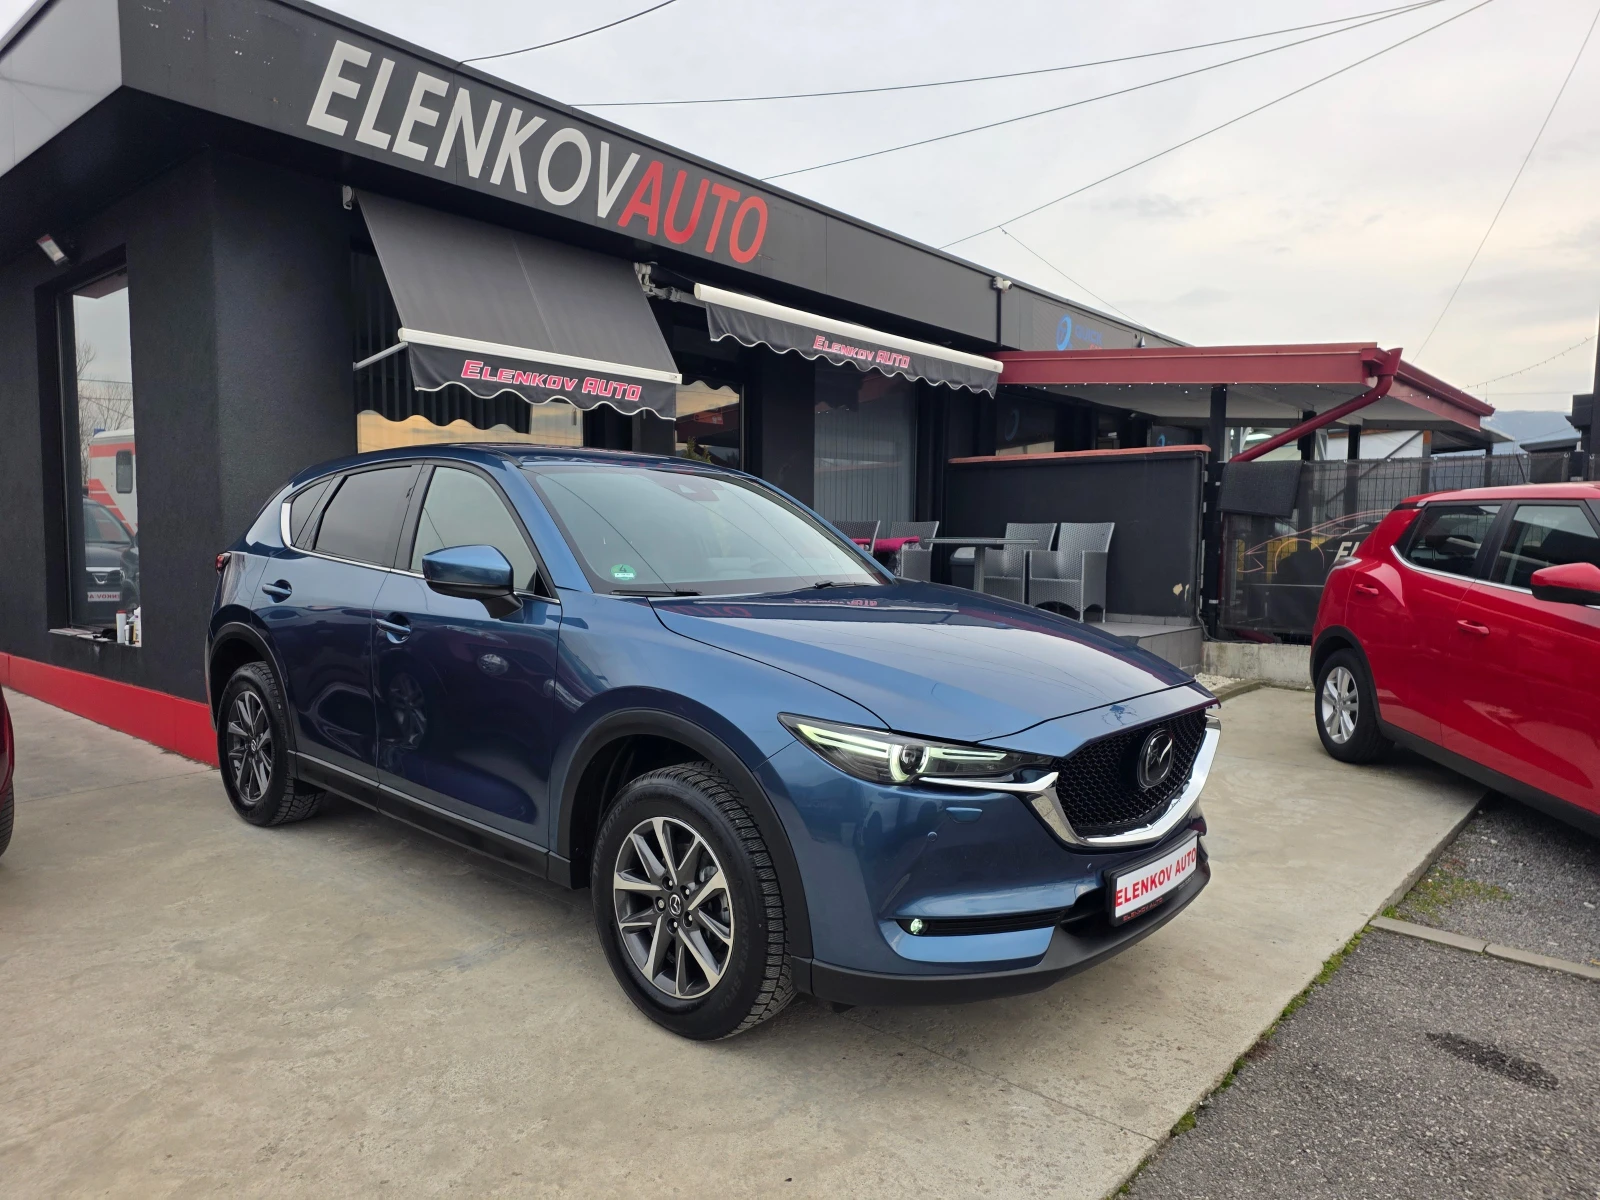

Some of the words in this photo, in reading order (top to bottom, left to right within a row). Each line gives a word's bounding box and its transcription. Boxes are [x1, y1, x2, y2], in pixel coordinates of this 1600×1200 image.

[812, 334, 875, 361] ELENKOV
[876, 349, 911, 369] AUTO
[460, 359, 578, 391] ELENKOV
[581, 376, 642, 401] AUTO
[619, 564, 627, 573] 4
[1115, 864, 1172, 908] ELENKOV
[1175, 847, 1197, 877] AUTO
